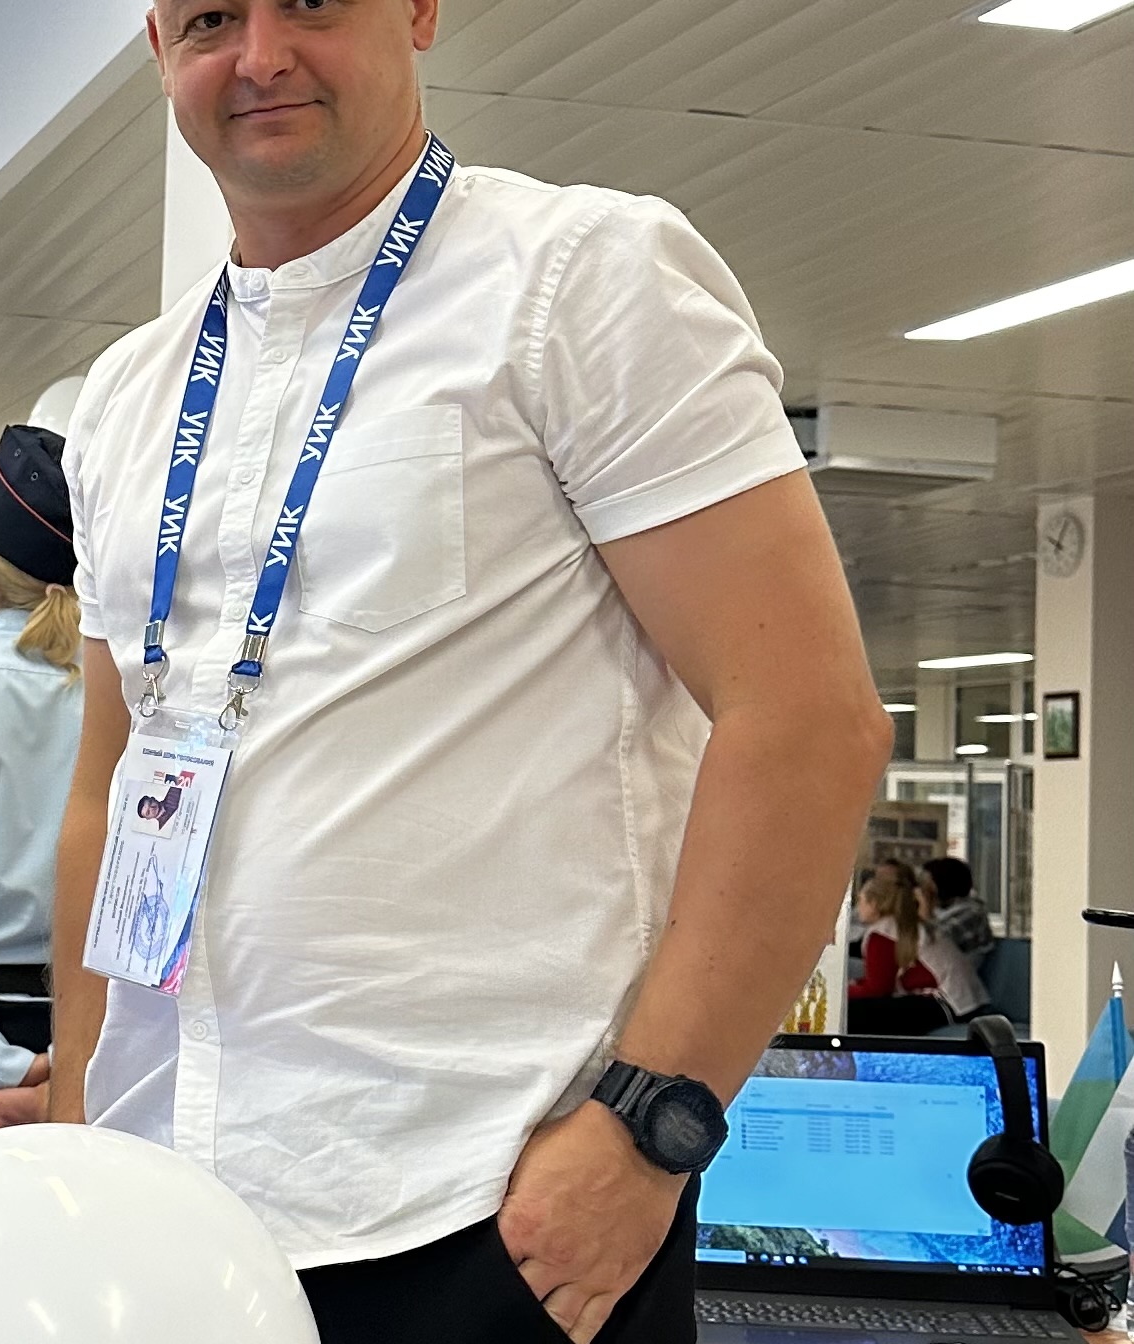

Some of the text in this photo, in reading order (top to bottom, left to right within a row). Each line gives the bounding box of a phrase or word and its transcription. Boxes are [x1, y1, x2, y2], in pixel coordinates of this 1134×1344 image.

[419, 141, 453, 188] УИК
[375, 211, 425, 268] УИК
[190, 330, 225, 386] УИК
[336, 303, 381, 363] УИК
[171, 410, 209, 468] УИК
[299, 401, 343, 464] УИК
[158, 493, 189, 557] УИК
[265, 504, 305, 568] УИК
